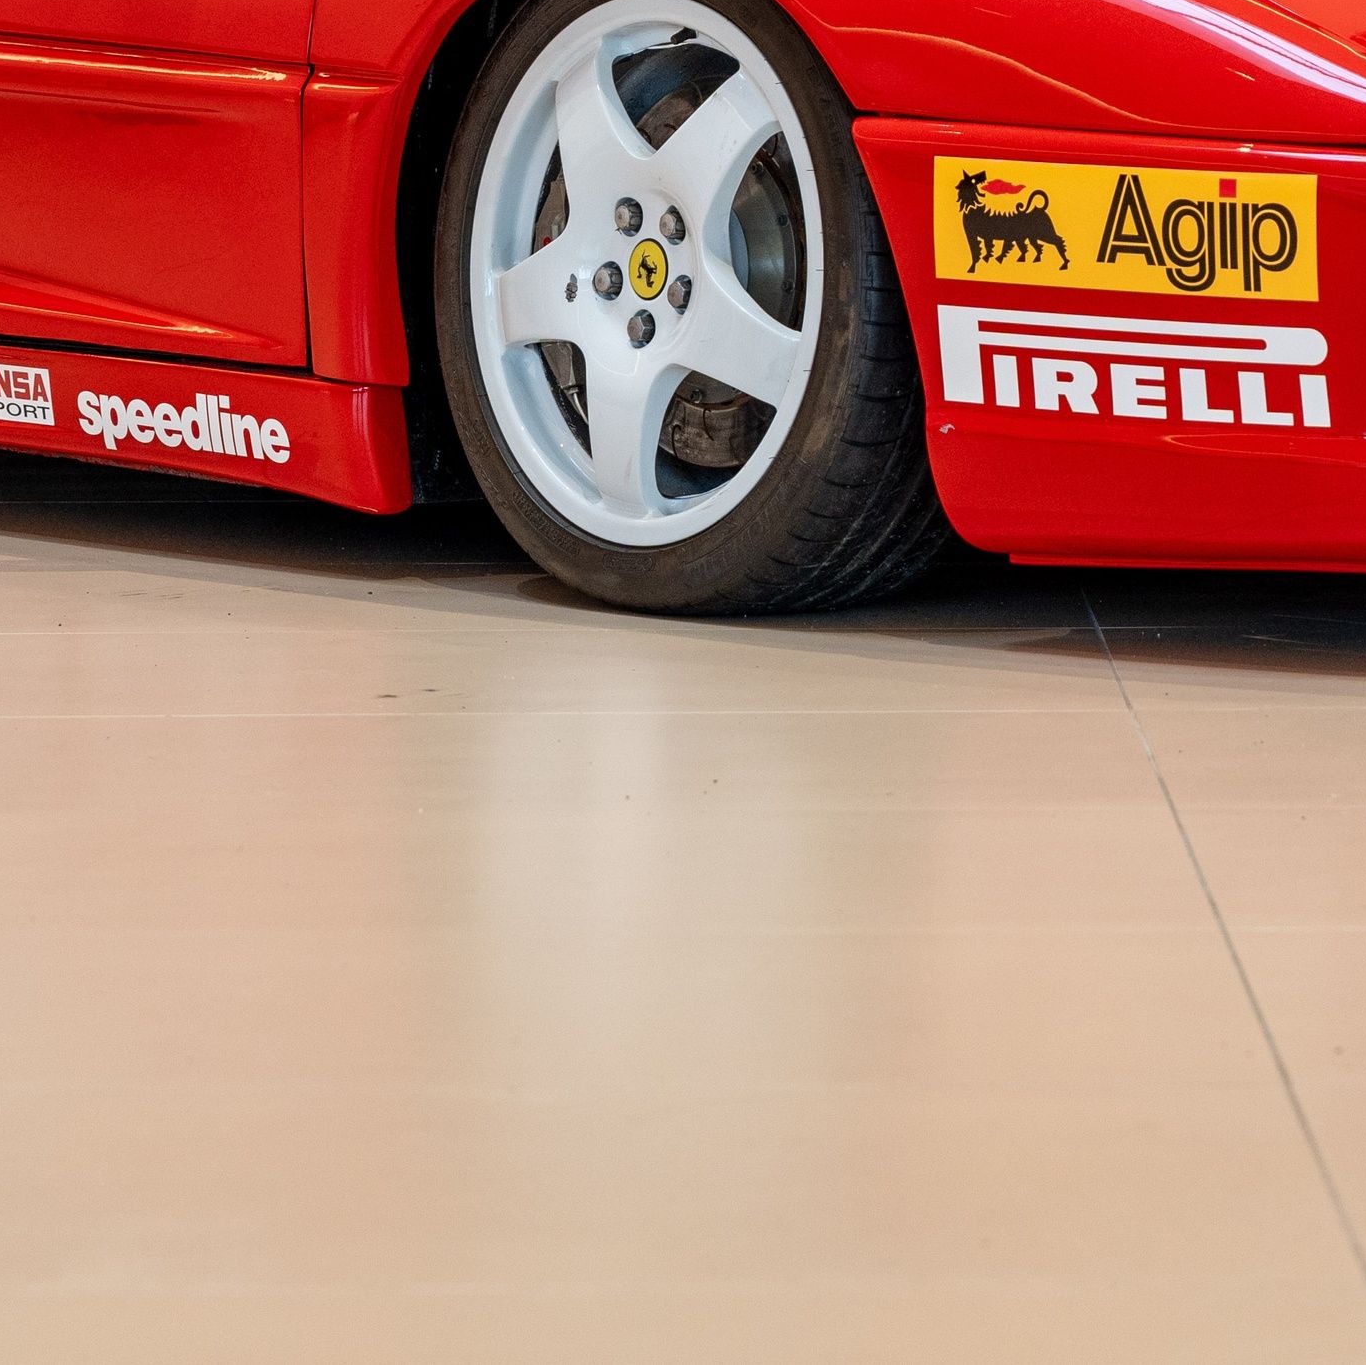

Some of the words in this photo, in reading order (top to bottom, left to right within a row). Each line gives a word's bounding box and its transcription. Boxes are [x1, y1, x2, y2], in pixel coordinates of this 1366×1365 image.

[1096, 173, 1298, 292] Agip
[936, 304, 1332, 428] PIRELLI
[76, 389, 291, 464] speedline
